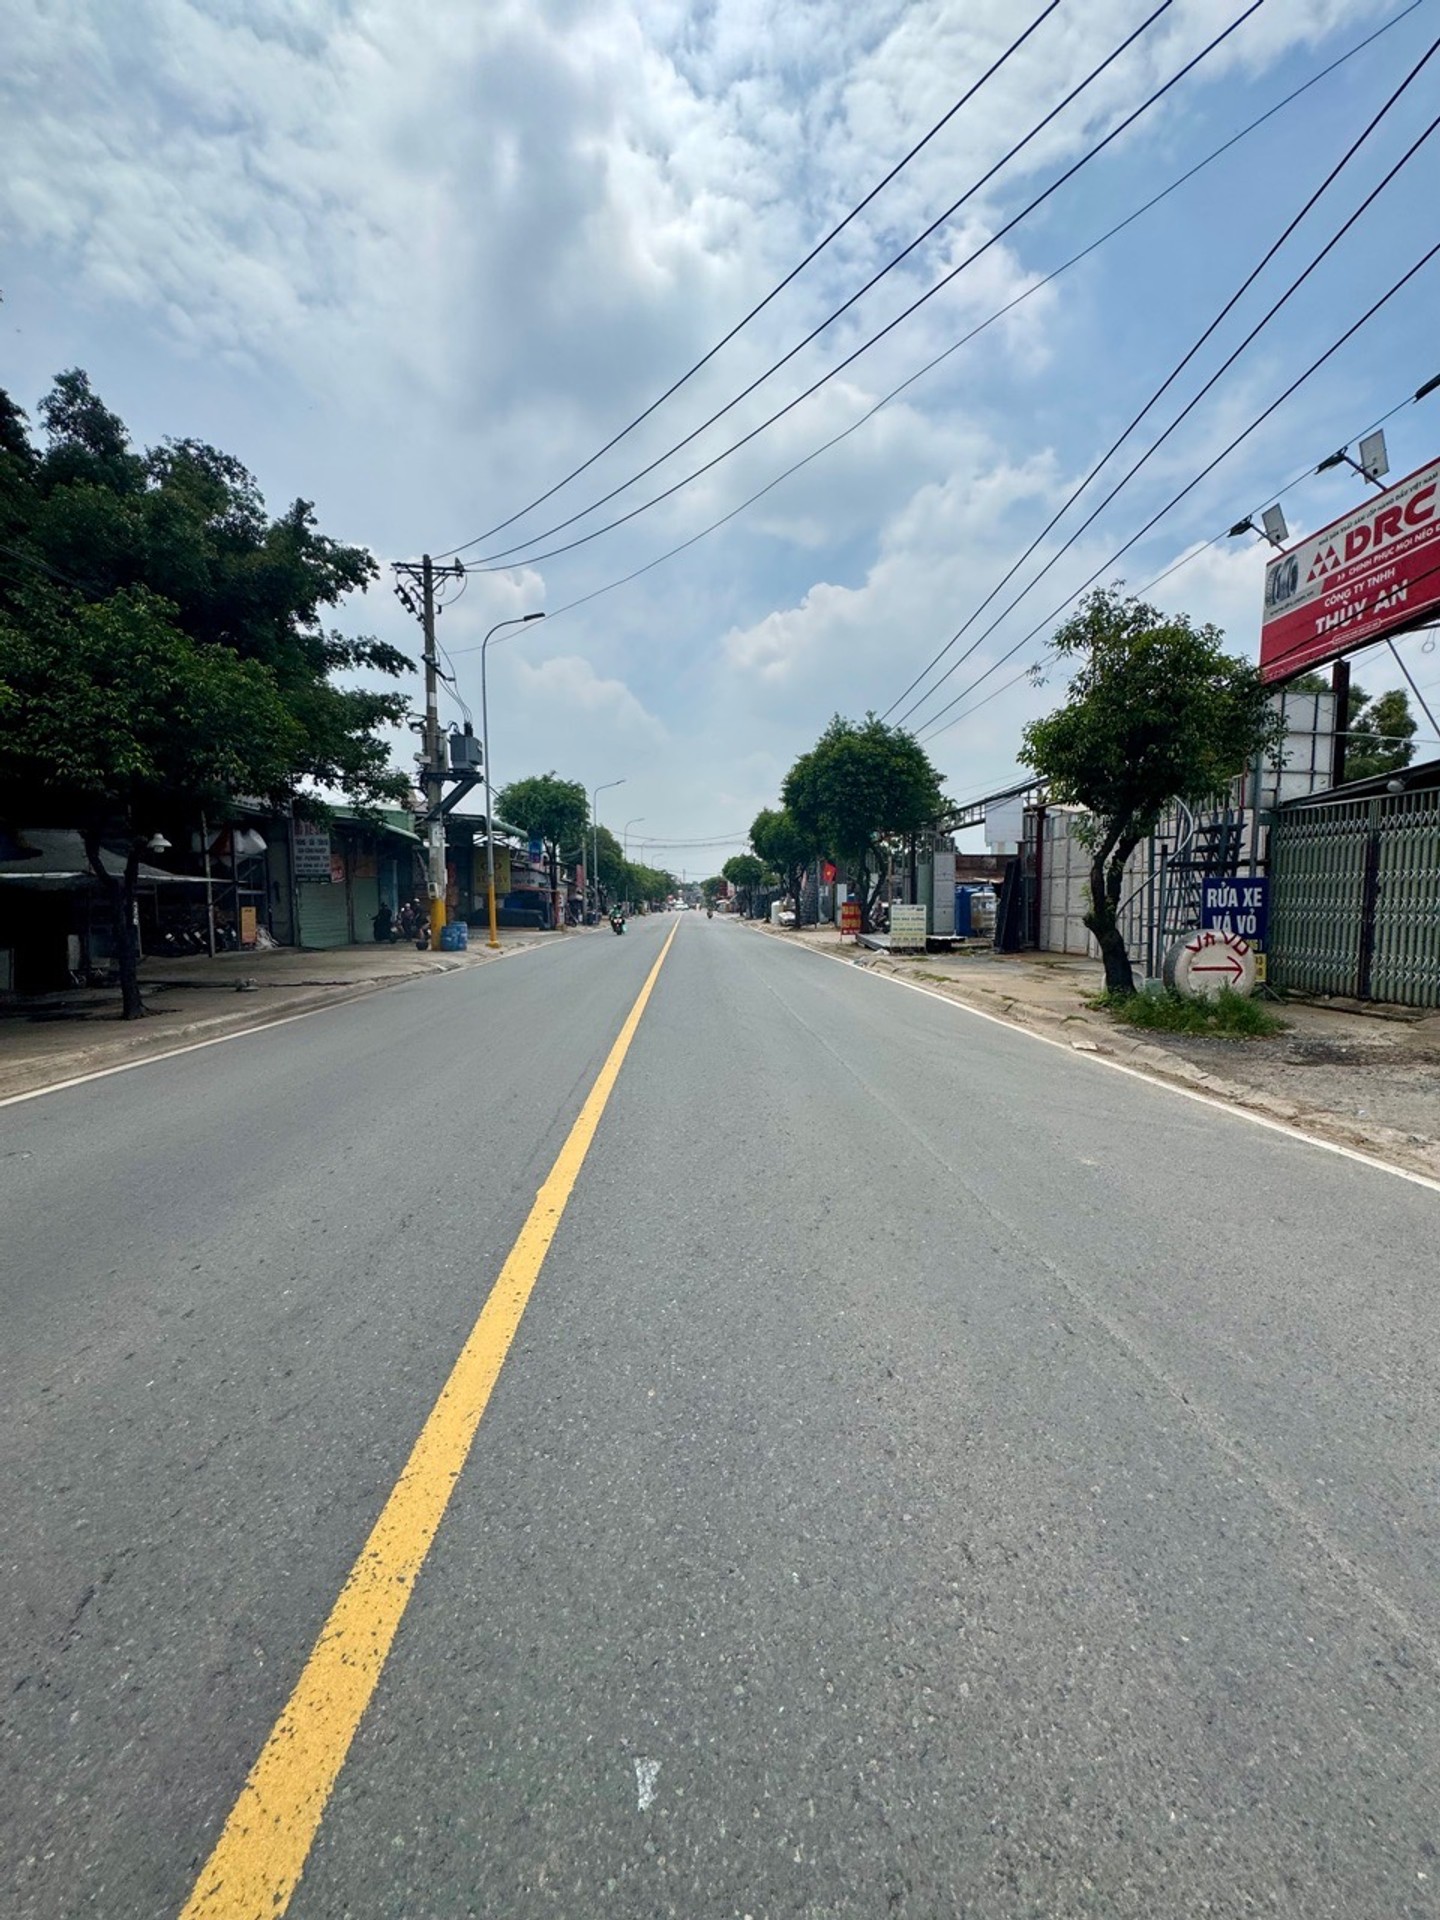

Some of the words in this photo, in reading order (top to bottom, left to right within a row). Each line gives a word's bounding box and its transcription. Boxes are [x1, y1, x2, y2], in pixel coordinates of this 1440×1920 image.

[1344, 483, 1437, 562] DRC
[1324, 588, 1352, 608] CÔNG
[1354, 581, 1366, 594] TY
[1367, 567, 1396, 588] TNHH
[1374, 578, 1409, 614] AN
[1206, 881, 1239, 908] RỬA
[1242, 887, 1263, 907] XE
[1212, 910, 1233, 933] VÁ
[1236, 908, 1257, 935] VỎ
